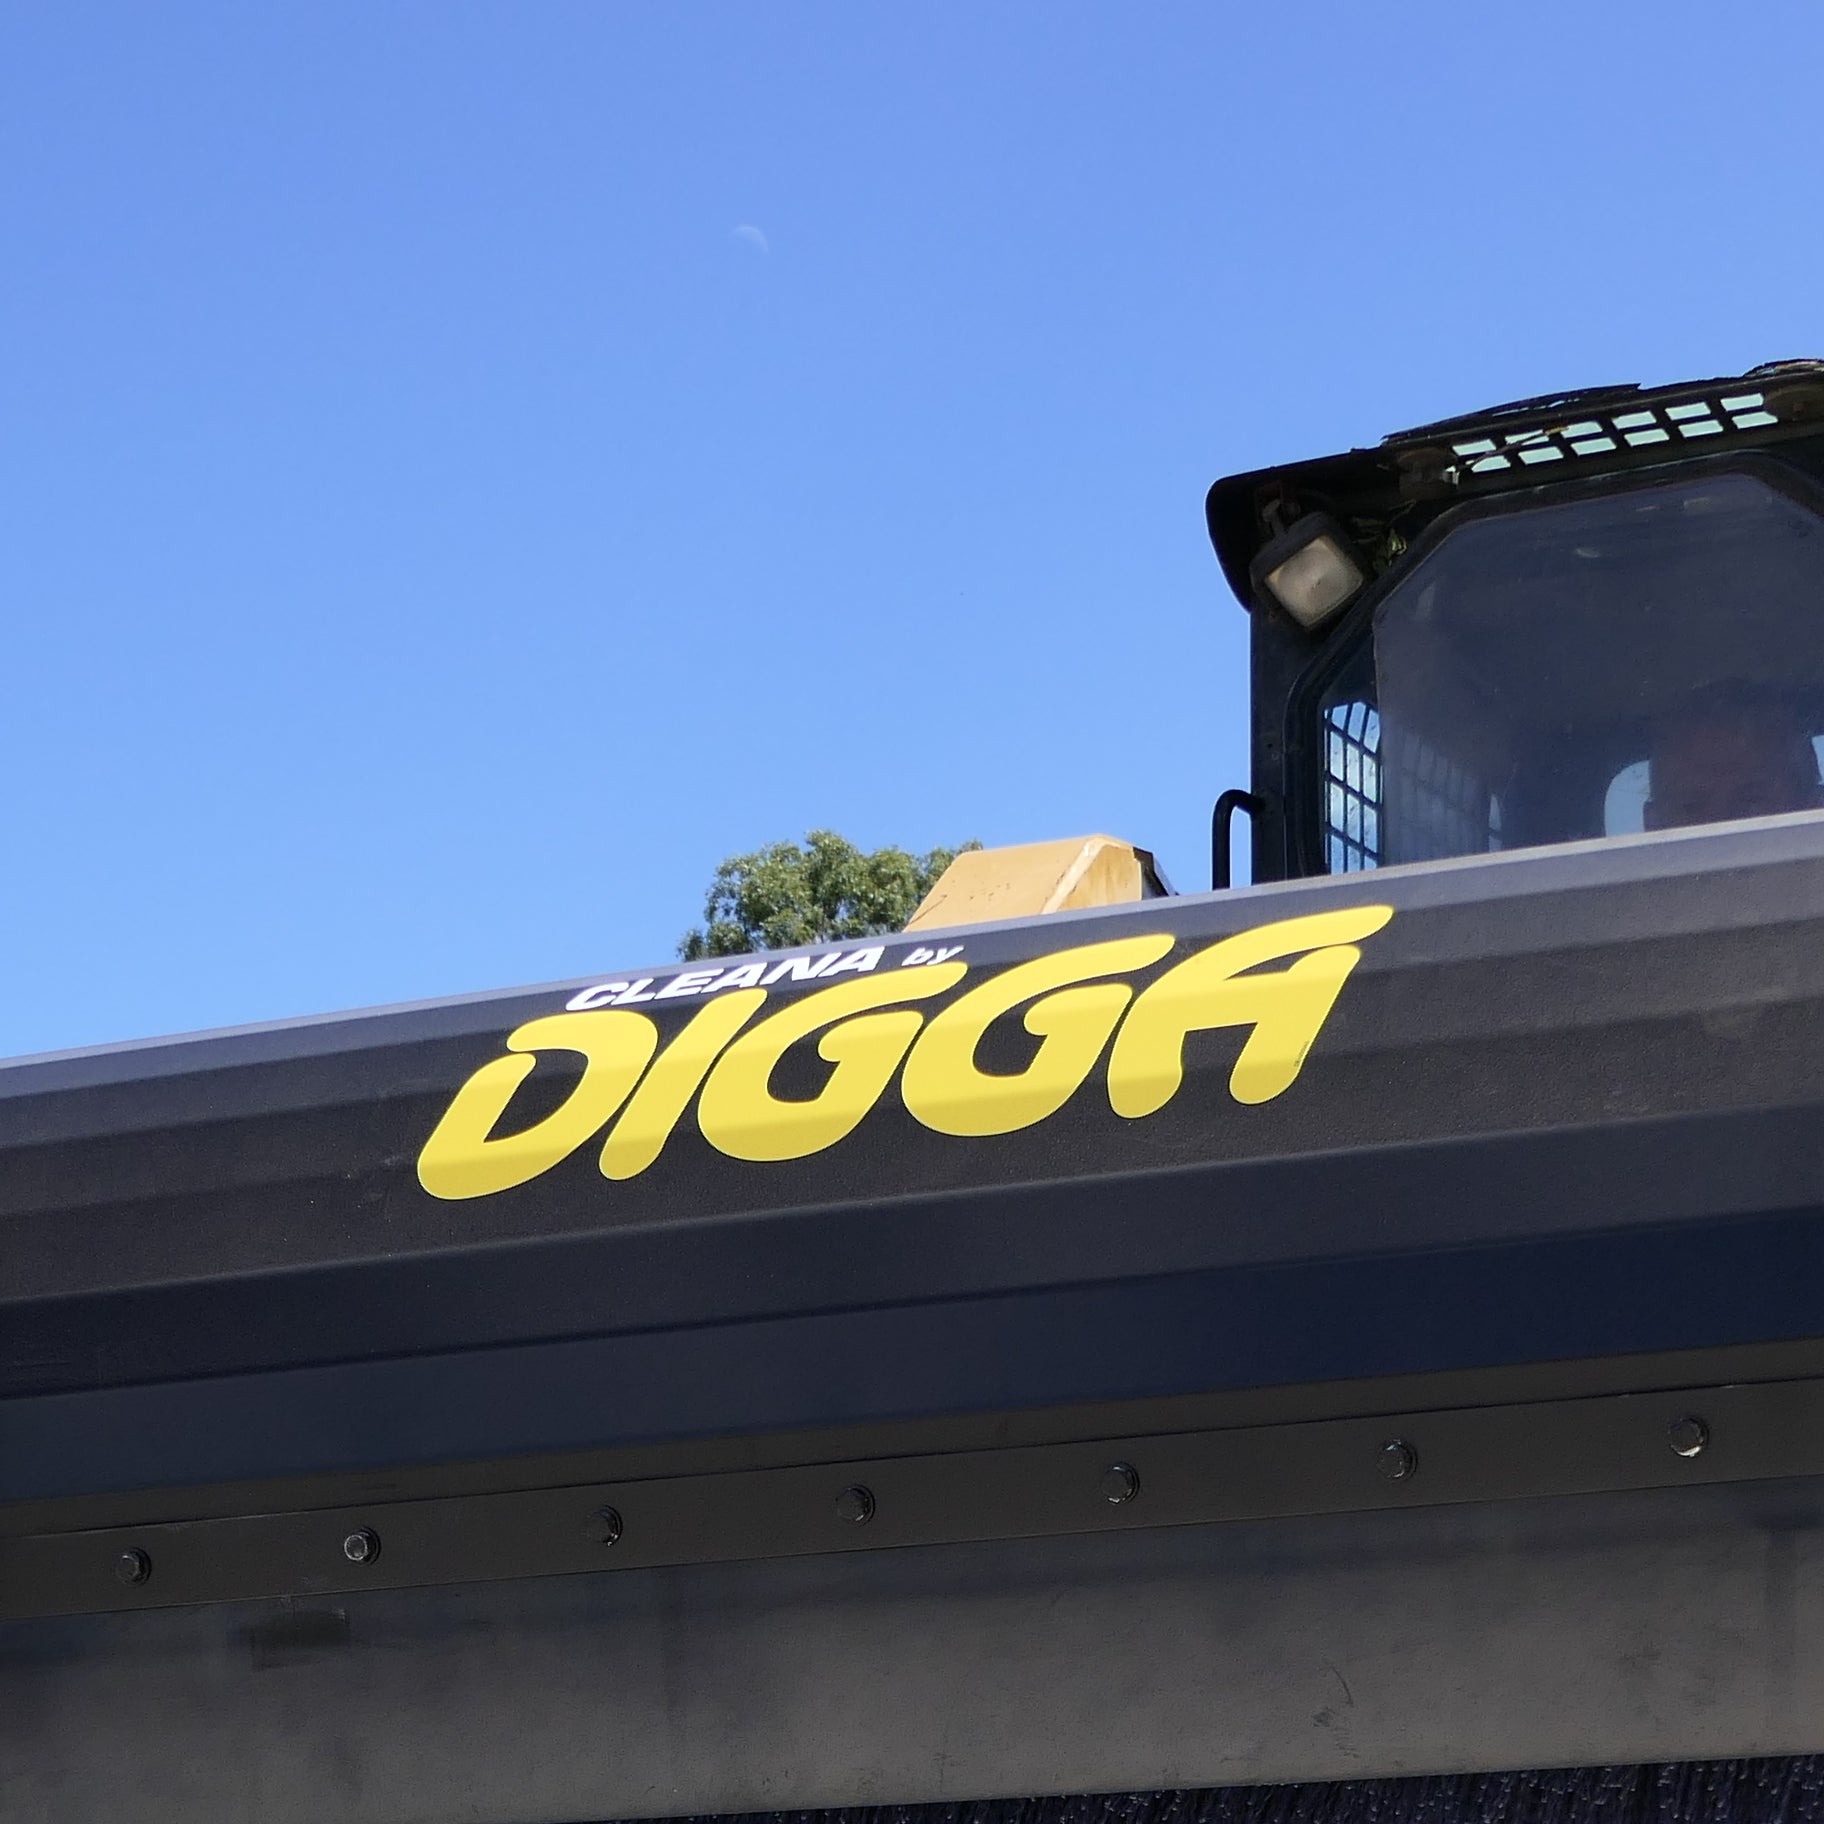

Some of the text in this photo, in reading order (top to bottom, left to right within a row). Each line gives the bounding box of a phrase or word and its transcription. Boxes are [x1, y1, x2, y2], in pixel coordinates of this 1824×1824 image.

[416, 905, 1395, 1201] DIGGA
[565, 944, 965, 1012] CLEANA by
